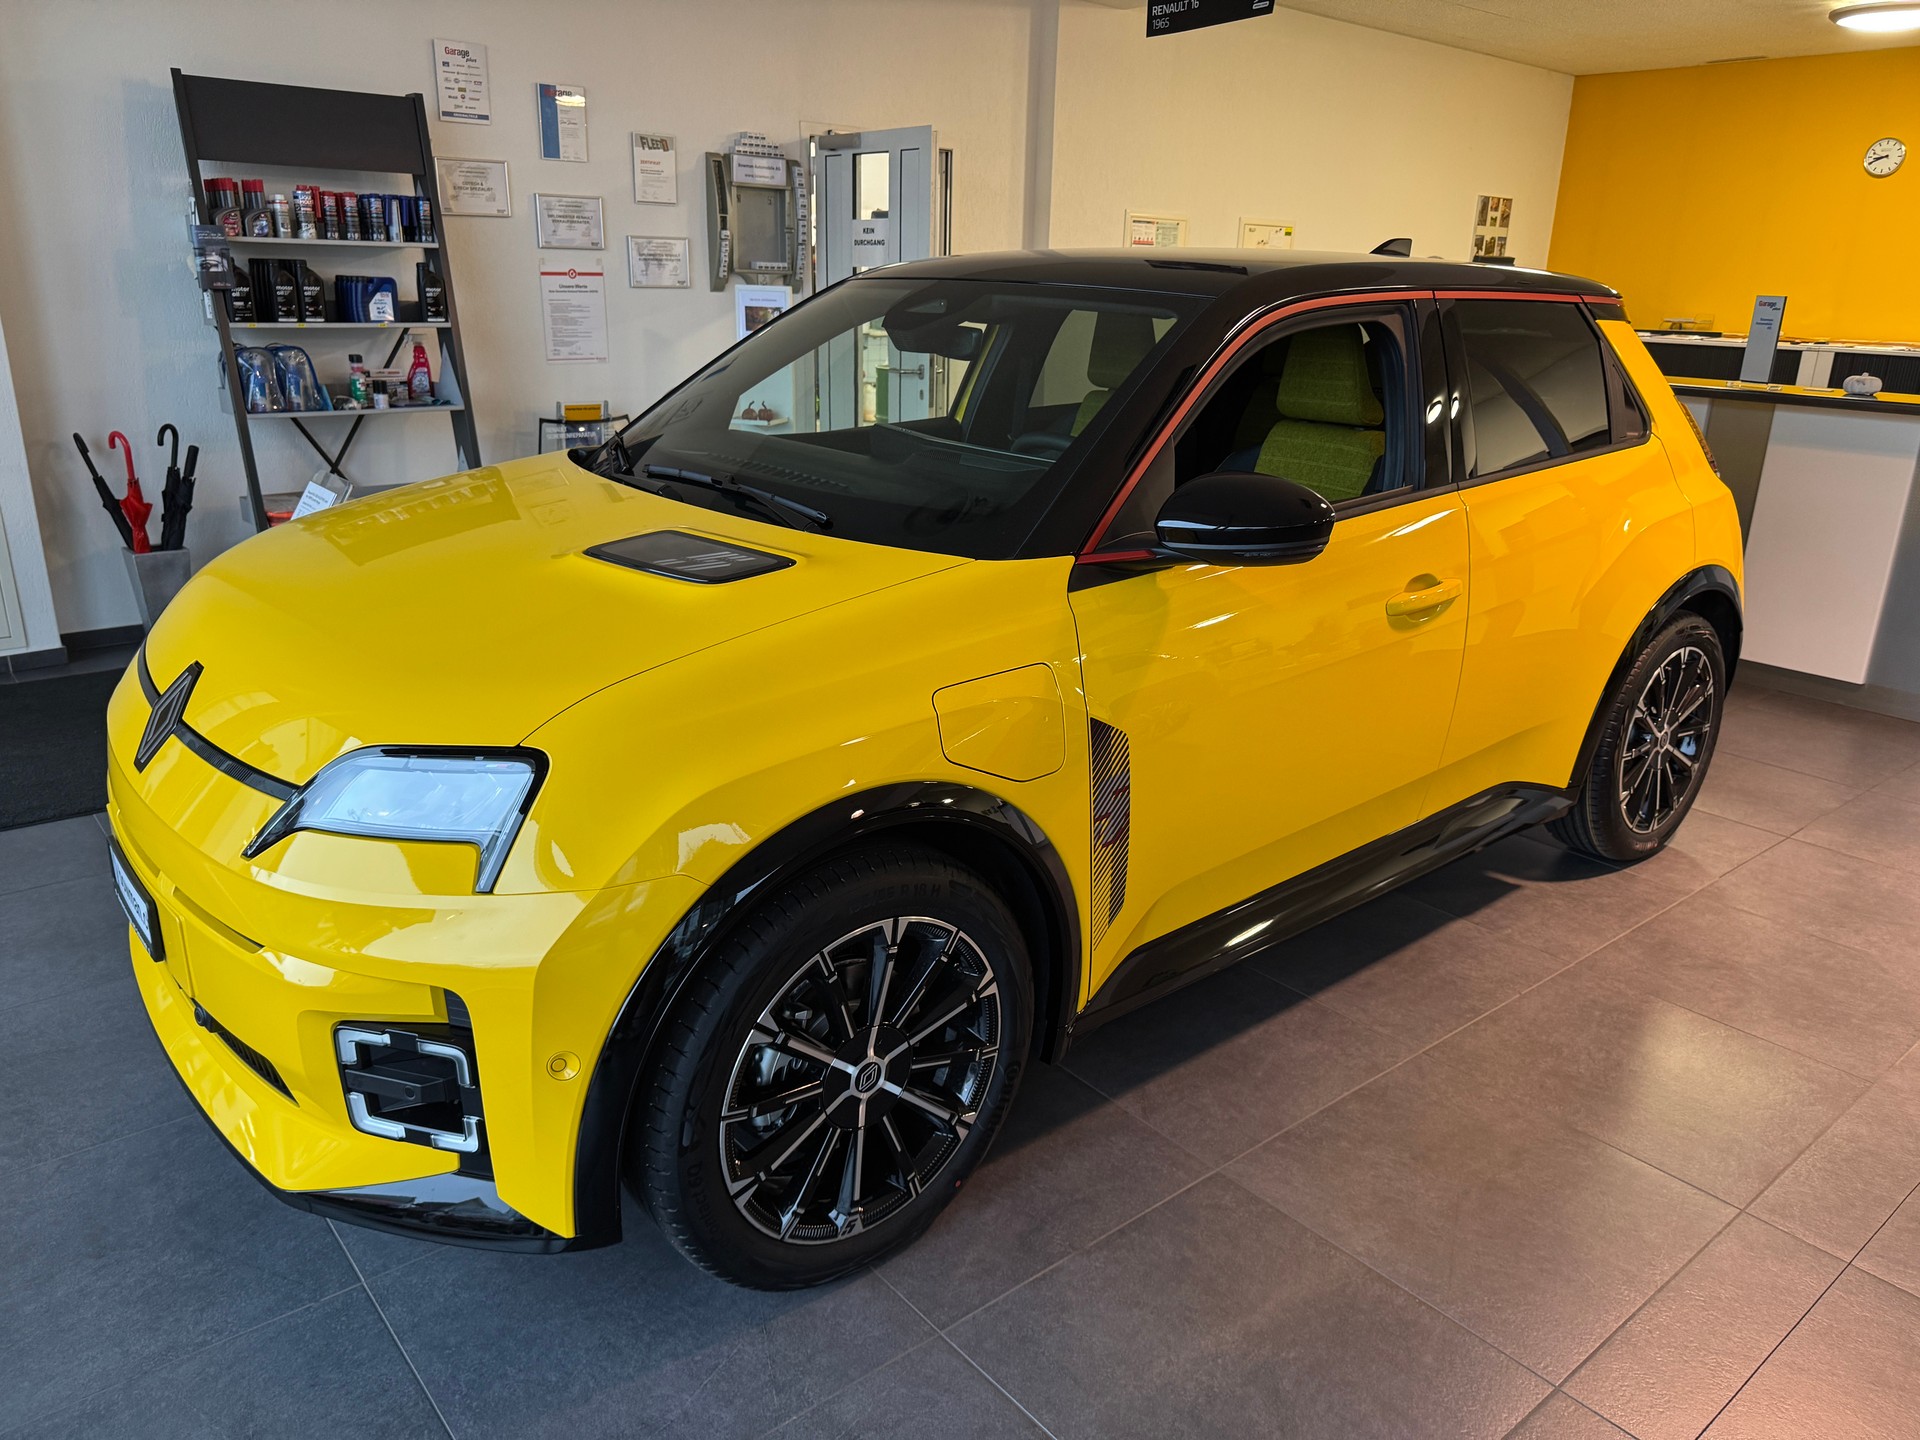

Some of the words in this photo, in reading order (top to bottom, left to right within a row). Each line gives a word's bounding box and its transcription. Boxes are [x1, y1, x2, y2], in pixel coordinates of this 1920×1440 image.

[1152, 1, 1188, 16] RENAULT
[1152, 17, 1170, 30] 1965
[445, 46, 470, 58] Garage
